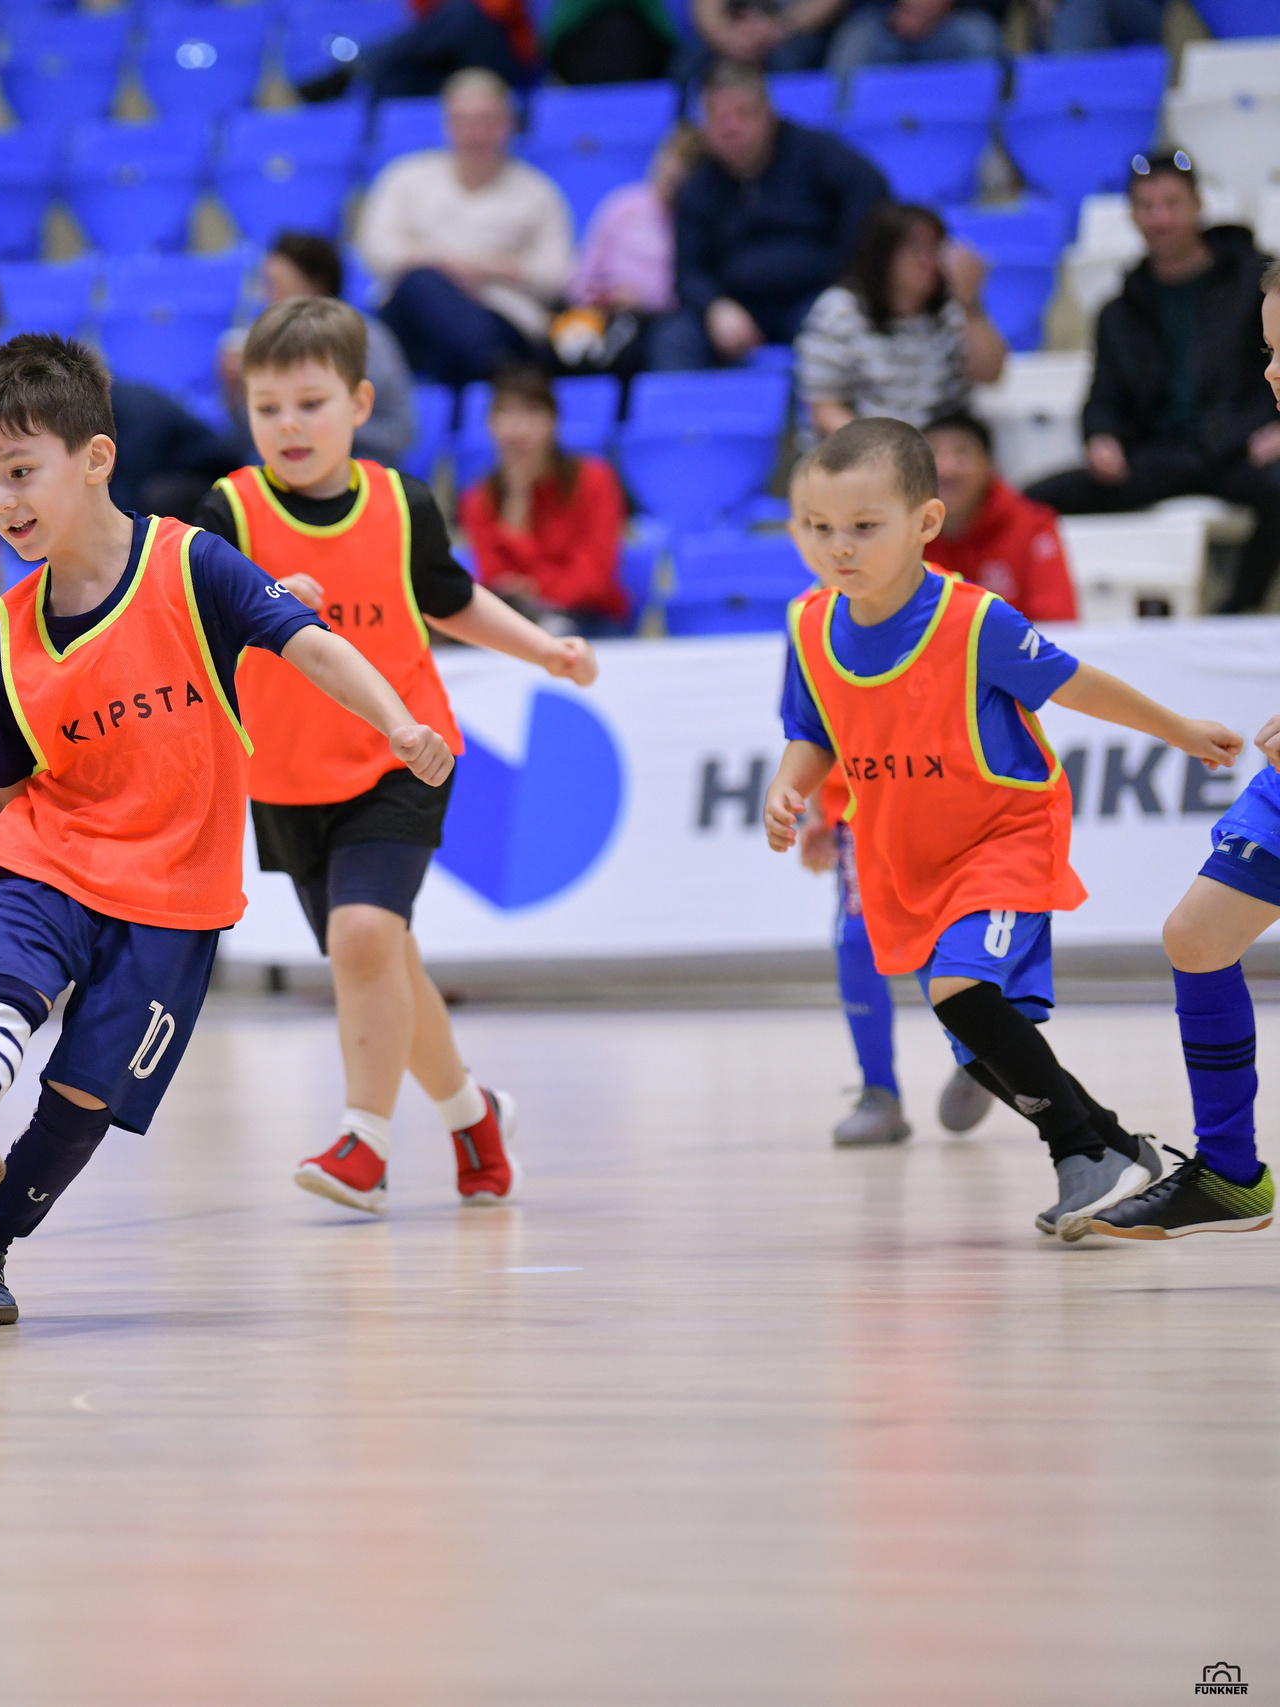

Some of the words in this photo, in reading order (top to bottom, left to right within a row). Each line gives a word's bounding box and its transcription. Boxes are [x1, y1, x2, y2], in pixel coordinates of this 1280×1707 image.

[61, 680, 204, 744] KIPSTA
[984, 909, 1017, 958] 8
[128, 1000, 175, 1079] 10
